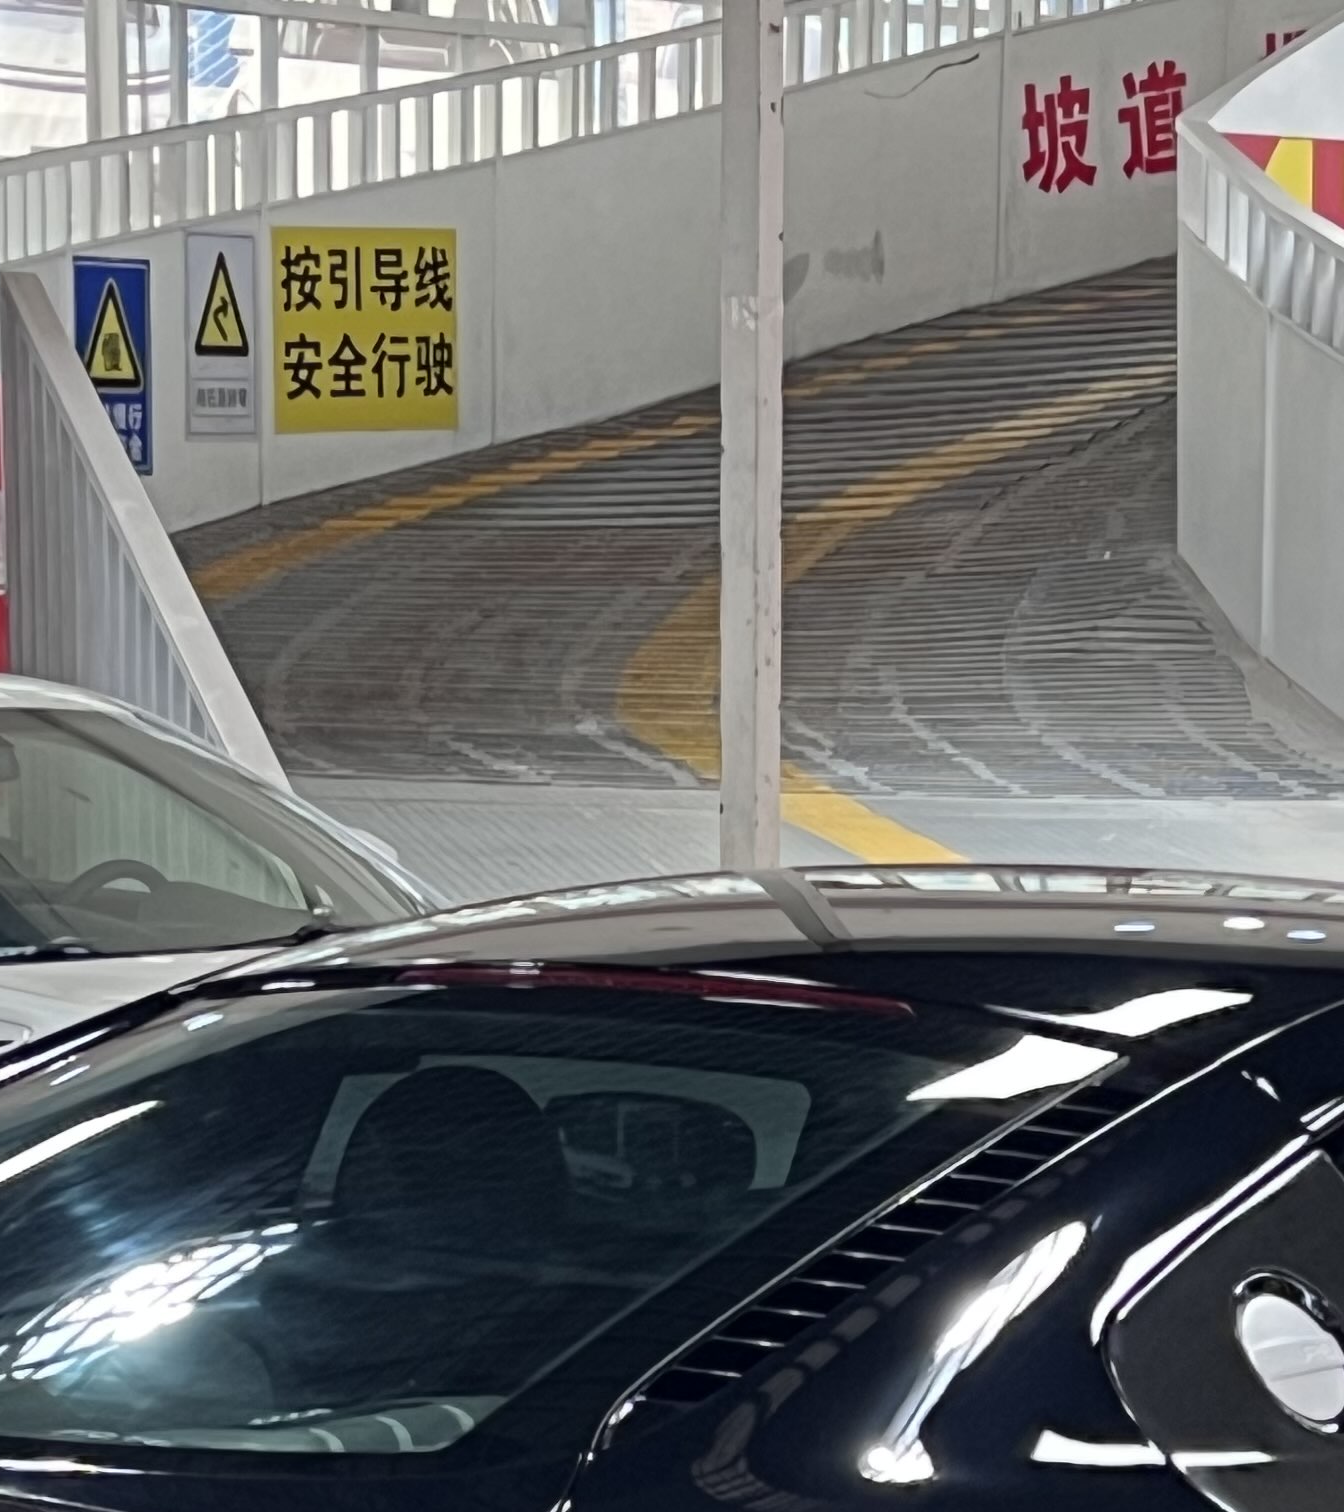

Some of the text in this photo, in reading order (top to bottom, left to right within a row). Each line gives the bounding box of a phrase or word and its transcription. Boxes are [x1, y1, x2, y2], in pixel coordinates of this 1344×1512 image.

[281, 245, 453, 313] 按引导线
[283, 332, 453, 401] 安全行驶
